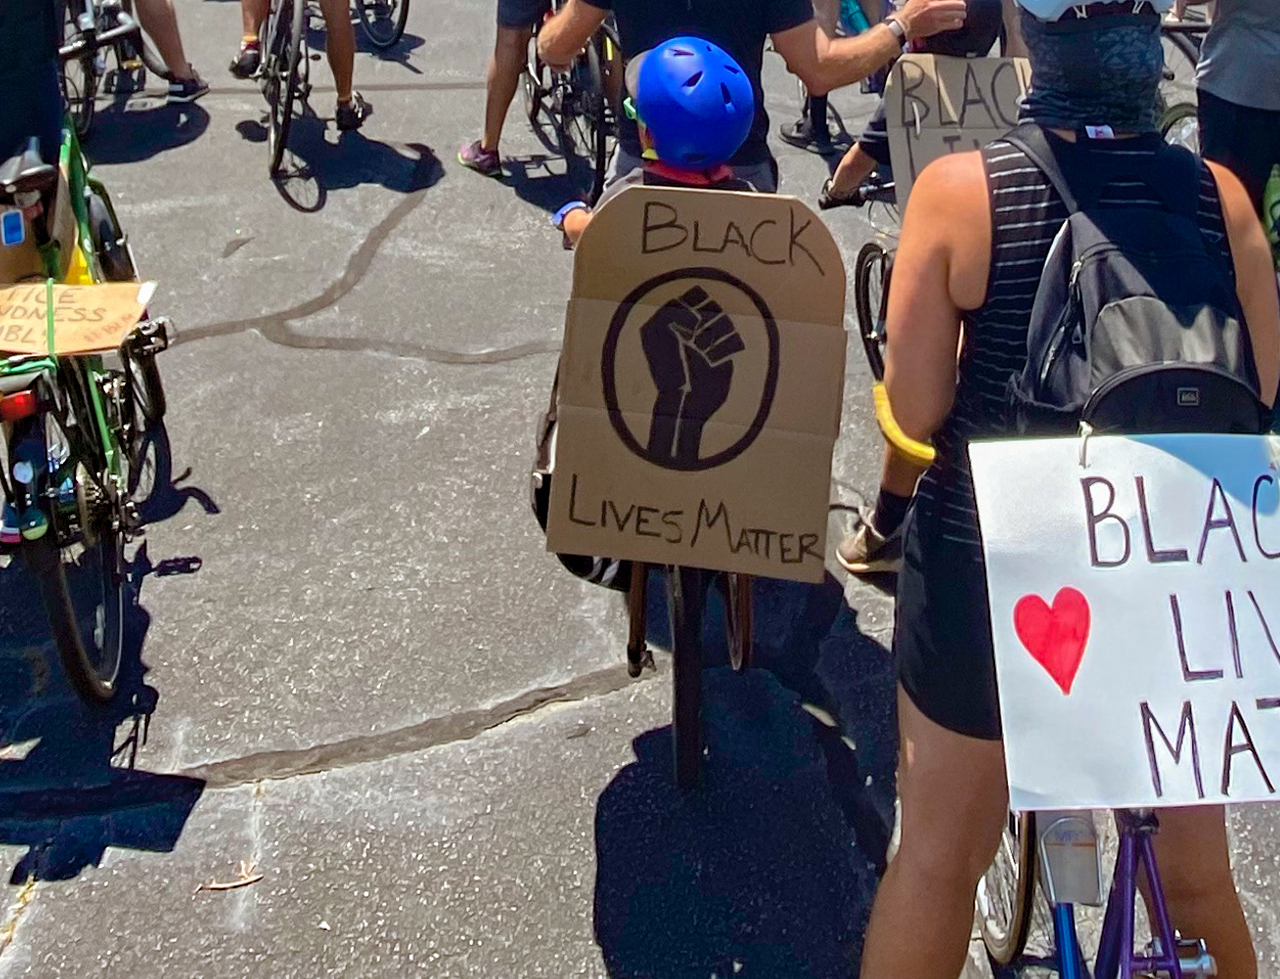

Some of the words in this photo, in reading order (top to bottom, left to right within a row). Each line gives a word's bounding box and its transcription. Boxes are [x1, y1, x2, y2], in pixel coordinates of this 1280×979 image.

[640, 201, 826, 277] BLACK
[569, 473, 684, 544] LIVES
[690, 498, 825, 563] MATTER
